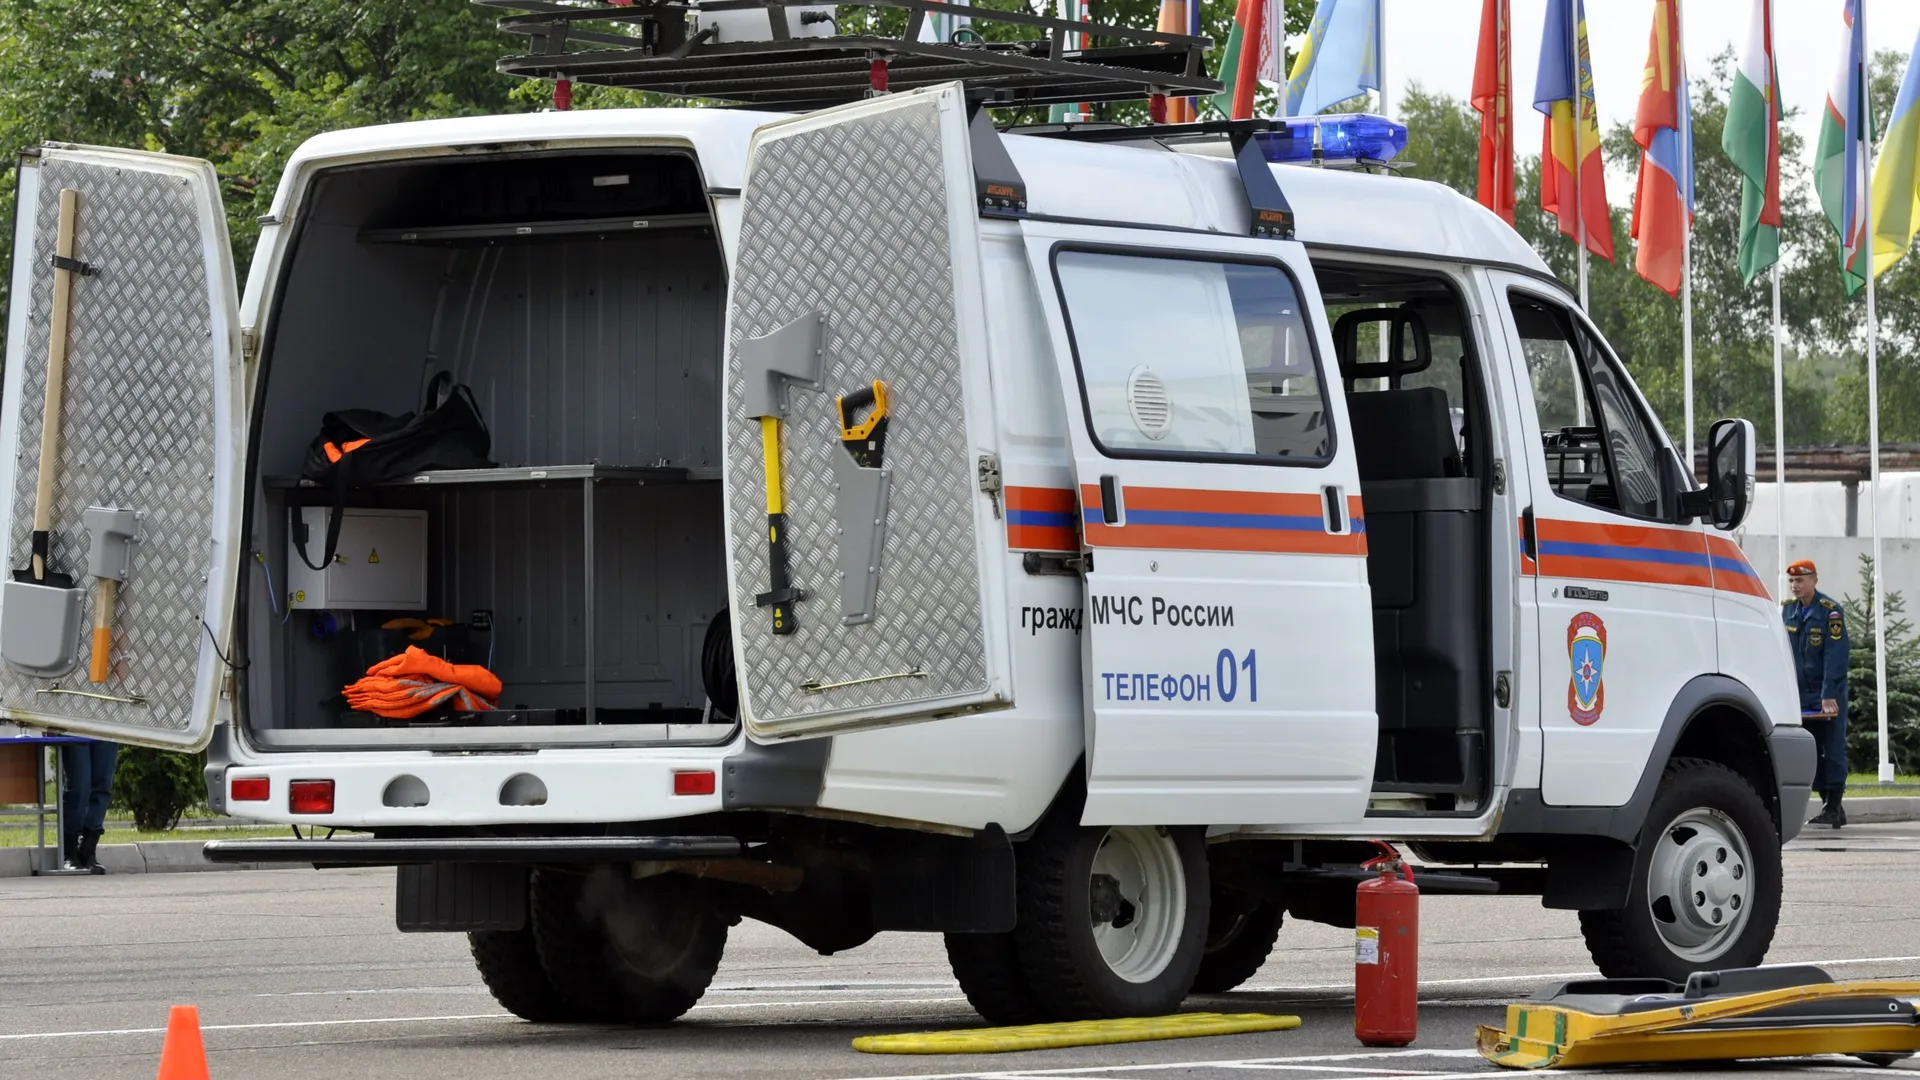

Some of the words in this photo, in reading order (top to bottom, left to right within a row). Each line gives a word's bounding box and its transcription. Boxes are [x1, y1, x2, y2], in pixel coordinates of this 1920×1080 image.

[1091, 595, 1143, 625] МЧС
[1151, 596, 1235, 627] России
[1101, 672, 1211, 701] ТЕЛЕФОН
[1216, 648, 1258, 703] 01
